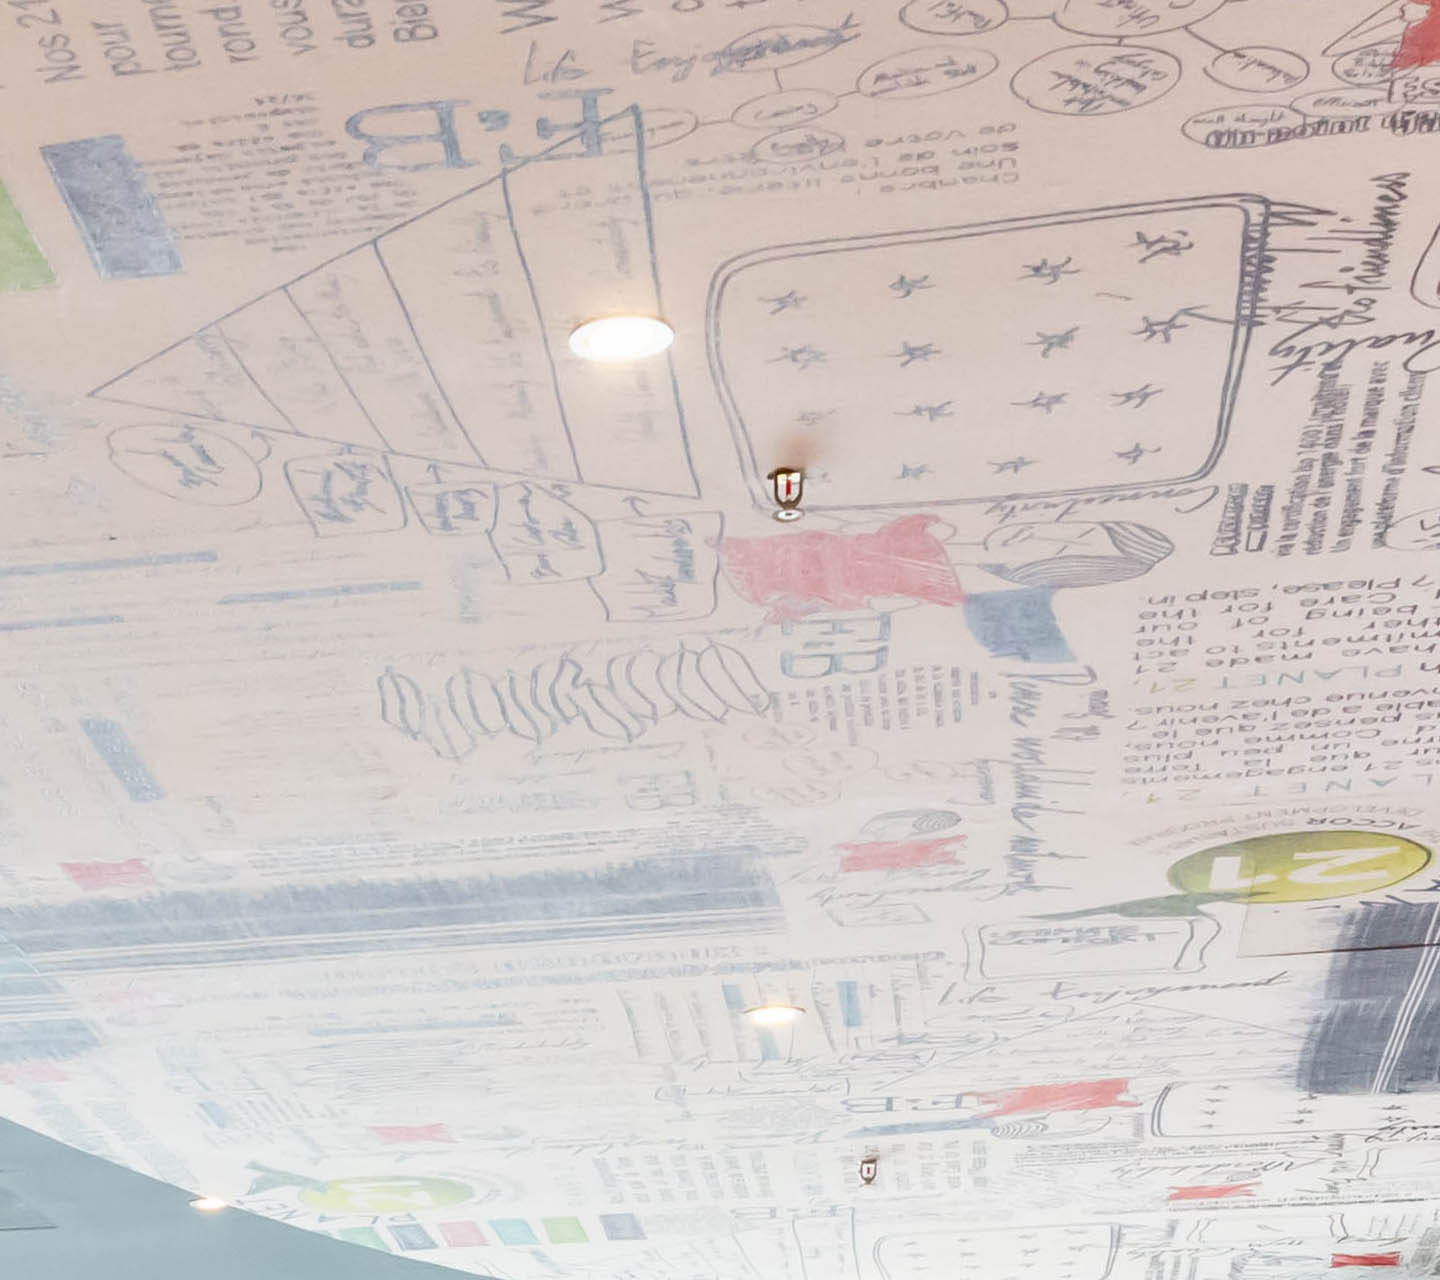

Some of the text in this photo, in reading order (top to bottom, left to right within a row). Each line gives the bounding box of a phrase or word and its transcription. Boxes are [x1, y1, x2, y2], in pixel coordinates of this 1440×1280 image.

[390, 0, 439, 43] Bie
[34, 33, 88, 85] Nos
[1211, 663, 1404, 692] PLANET
